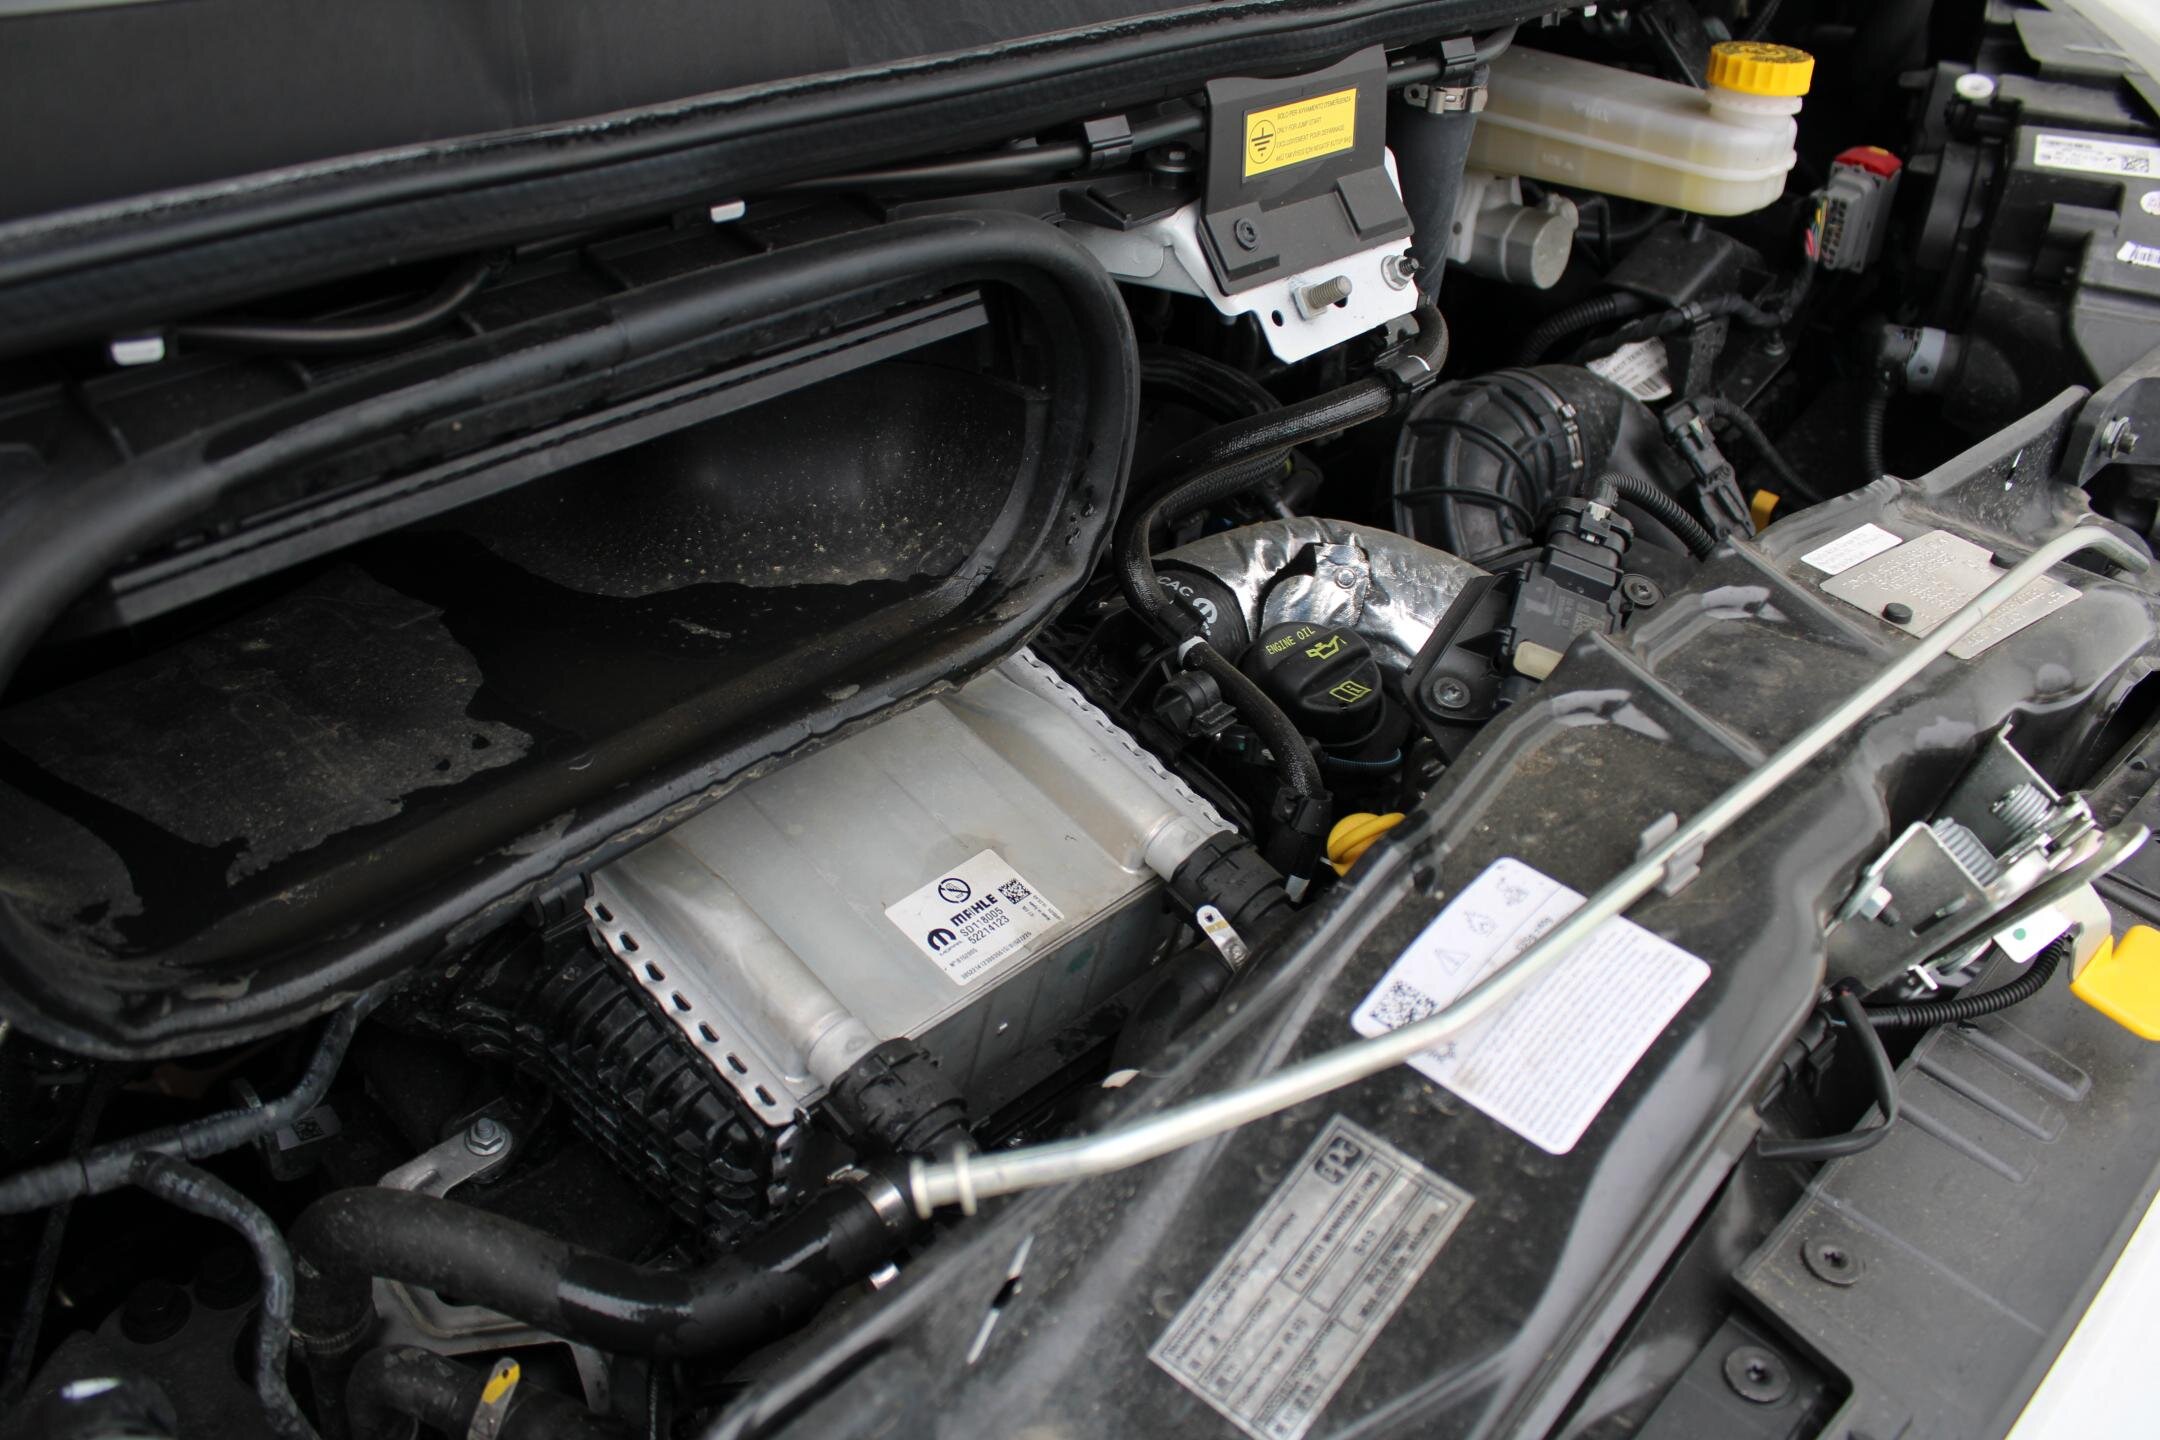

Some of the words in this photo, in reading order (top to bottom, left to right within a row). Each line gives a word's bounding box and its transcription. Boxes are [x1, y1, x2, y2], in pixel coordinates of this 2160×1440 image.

[1277, 125, 1287, 134] ONLY
[1288, 122, 1297, 130] FOR
[1297, 120, 1307, 128] JUMP
[1308, 116, 1321, 125] START
[1265, 635, 1296, 656] ENGINE
[1297, 626, 1316, 641] OIL
[950, 893, 998, 927] MAHLE
[960, 907, 1004, 938] SD118005
[967, 915, 1010, 945] 52214123
